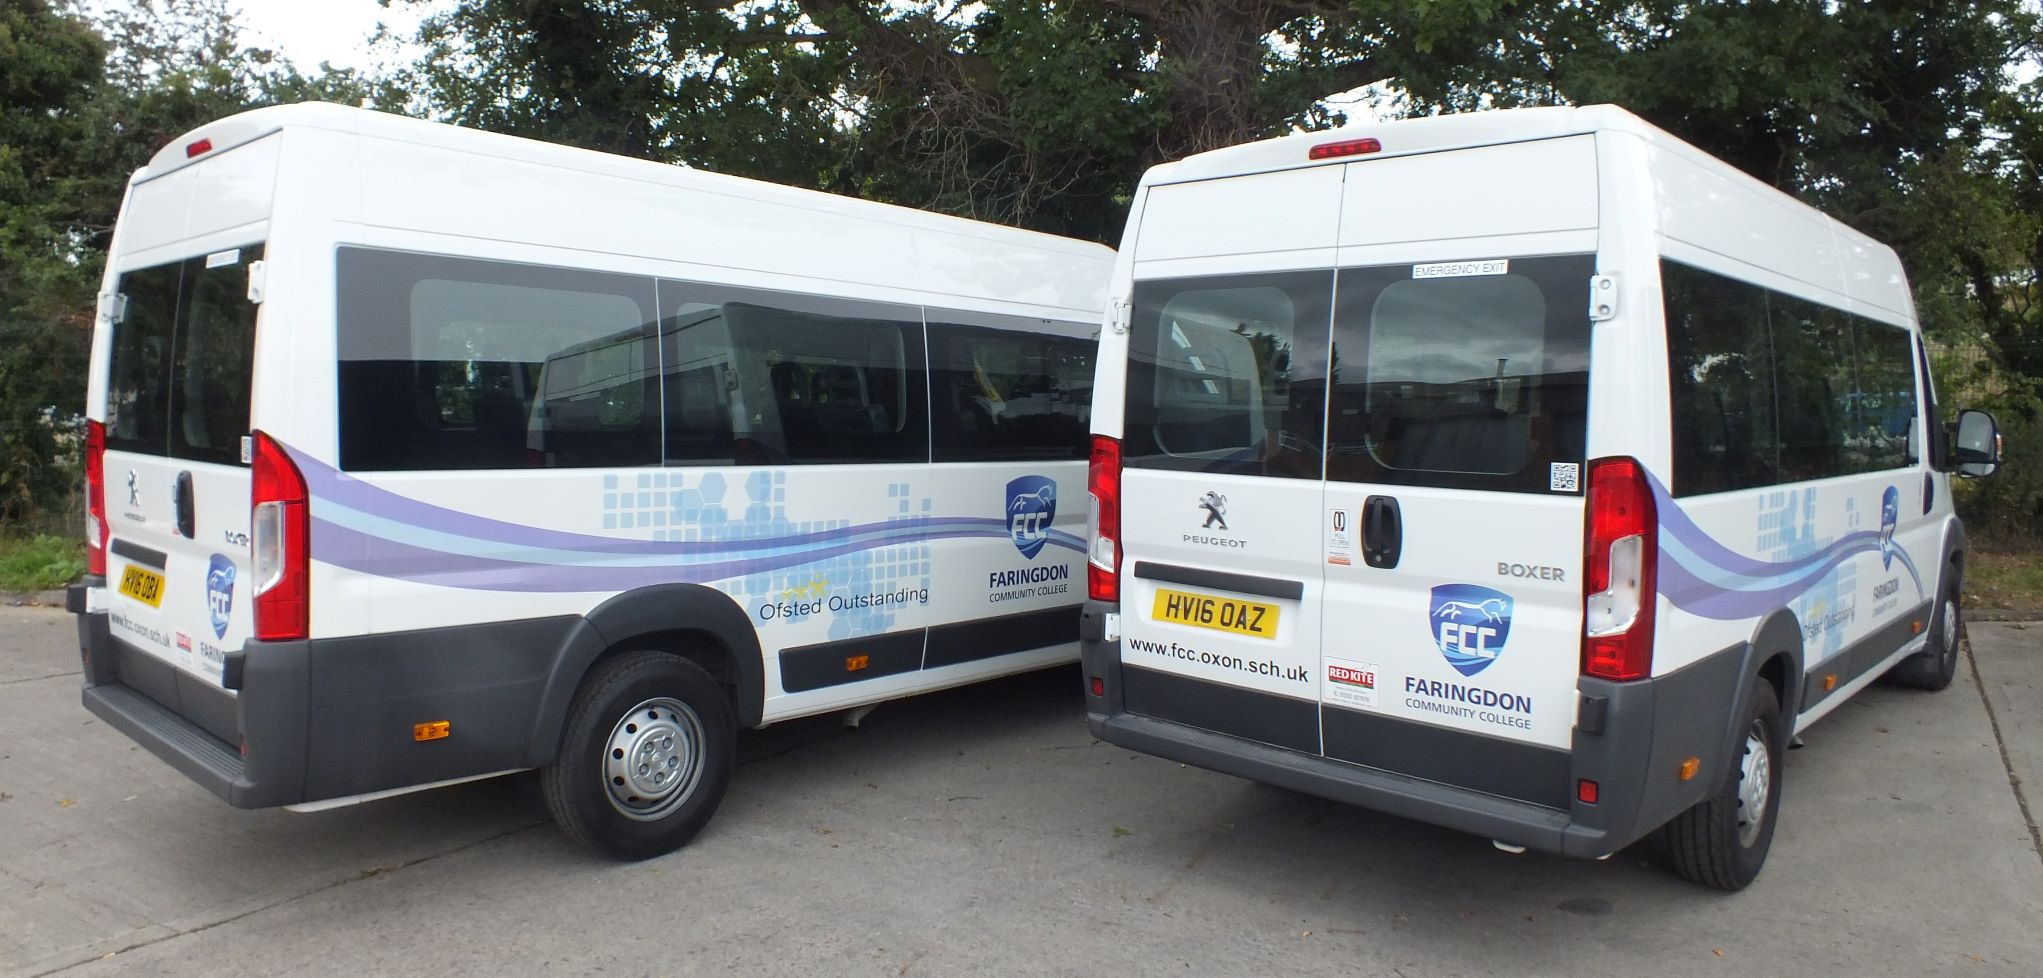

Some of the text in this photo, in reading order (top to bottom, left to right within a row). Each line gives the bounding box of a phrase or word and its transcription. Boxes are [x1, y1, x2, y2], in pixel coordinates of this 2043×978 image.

[1415, 262, 1505, 277] EMERGENCY EXIT
[1012, 512, 1048, 541] FCC
[1183, 534, 1247, 548] PEUGEOT
[989, 564, 1069, 589] FARINGDON
[1497, 561, 1565, 582] BOXER
[760, 587, 929, 620] Ofsted Outstanding
[989, 583, 1068, 603] COMMUNITY COLLEGE
[1165, 594, 1266, 632] HV16 OAZ
[110, 613, 171, 648] www.fcc.oxon.sch.uk
[1440, 621, 1497, 659] FCC
[1129, 638, 1309, 683] www.fcc.oxon.sch.uk
[1330, 667, 1373, 684] RED KITE
[1405, 676, 1532, 714] FARINGDON
[1405, 698, 1532, 730] COMMUNITY COLLEGE
